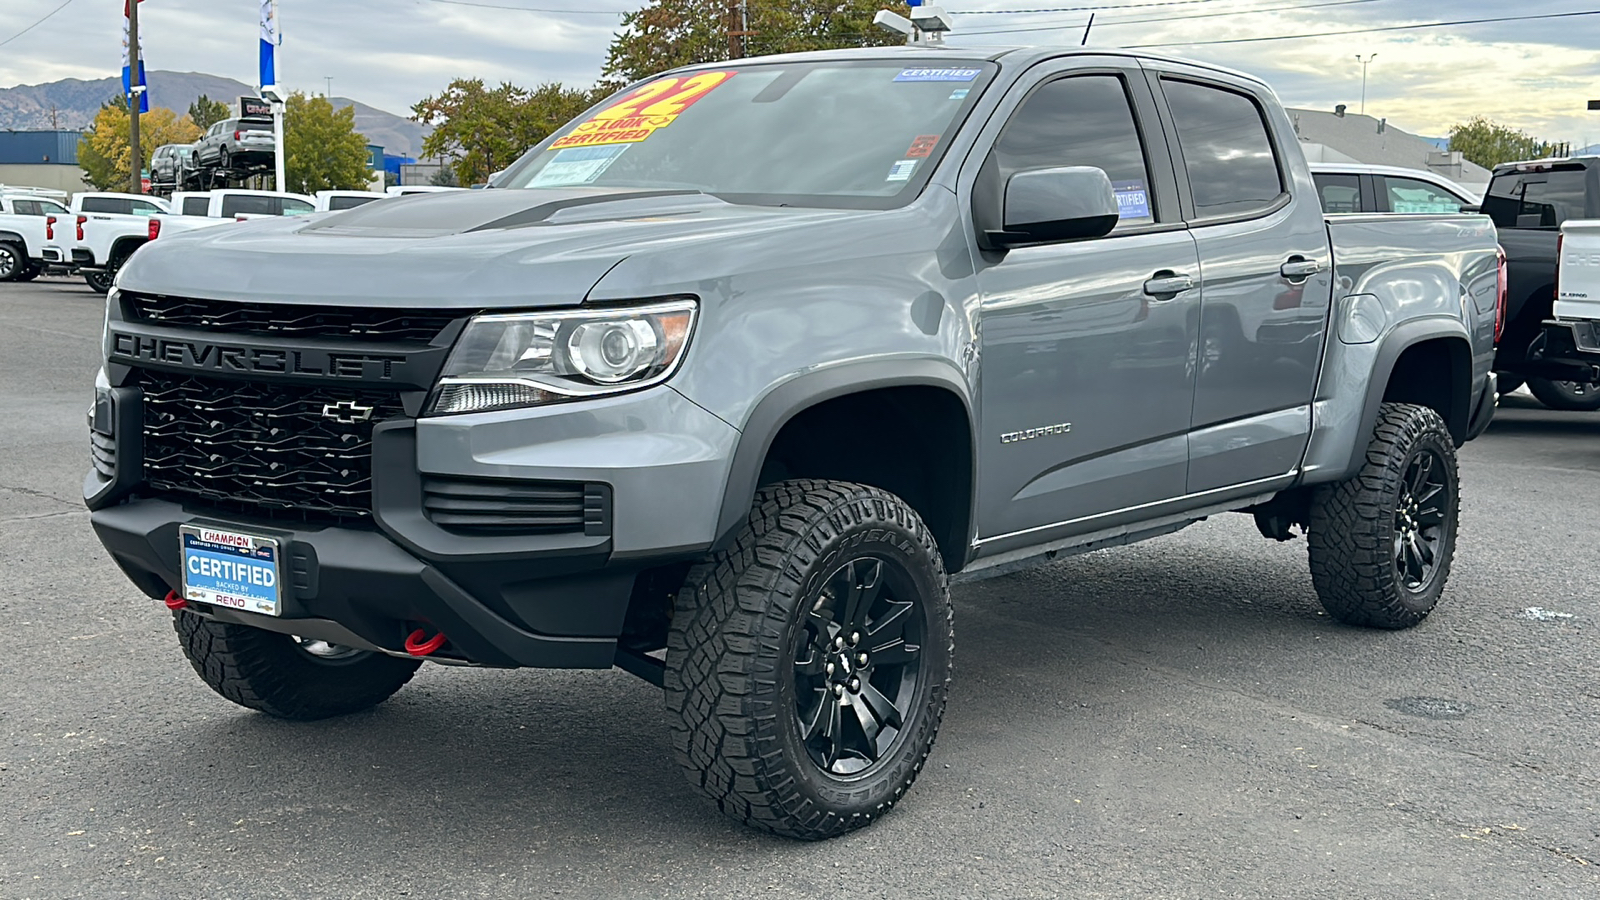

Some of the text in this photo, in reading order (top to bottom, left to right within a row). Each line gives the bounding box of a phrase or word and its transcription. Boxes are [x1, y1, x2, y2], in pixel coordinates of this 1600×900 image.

[901, 69, 976, 77] CERTIFIED
[593, 71, 727, 120] 22
[246, 104, 271, 114] GMC
[597, 117, 648, 131] LOOK
[552, 129, 650, 147] CERTIFIED
[1115, 193, 1145, 206] RTIFIED
[113, 333, 407, 380] CHEVROLET
[1000, 422, 1072, 444] COLORADO
[189, 539, 211, 548] CERTIFIED
[204, 531, 249, 547] CHAMPION
[187, 555, 275, 587] CERTIFIED
[215, 580, 240, 591] BACKED
[216, 595, 245, 607] RENO
